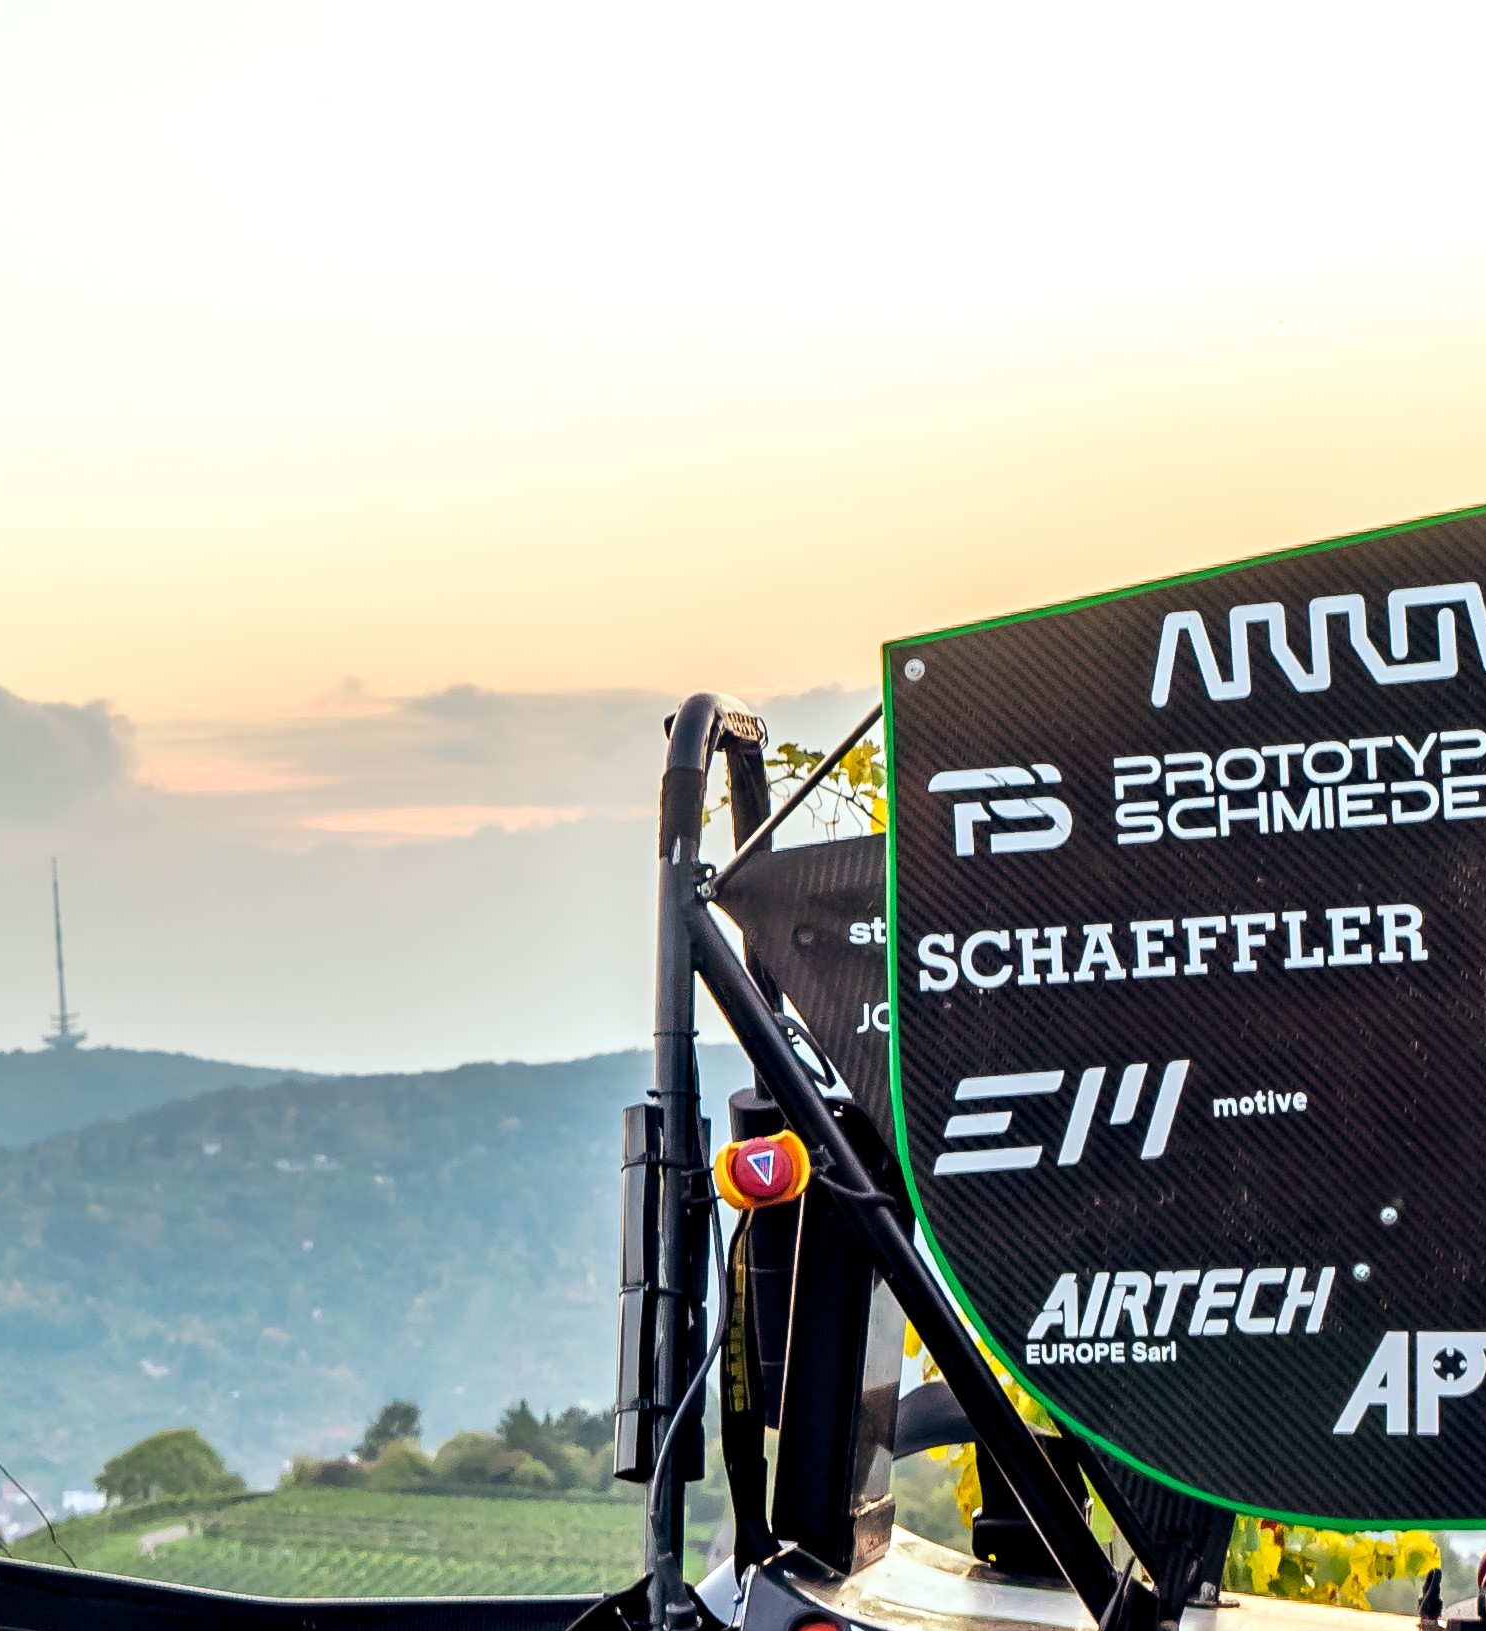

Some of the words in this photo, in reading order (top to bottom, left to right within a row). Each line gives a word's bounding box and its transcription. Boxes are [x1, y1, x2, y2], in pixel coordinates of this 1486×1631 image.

[918, 904, 1429, 992] SCHAEFFLER
[1212, 1087, 1308, 1118] motive
[1028, 1267, 1336, 1339] AIRTECH
[1025, 1342, 1127, 1365] EUROPE
[1130, 1341, 1177, 1364] Sarl
